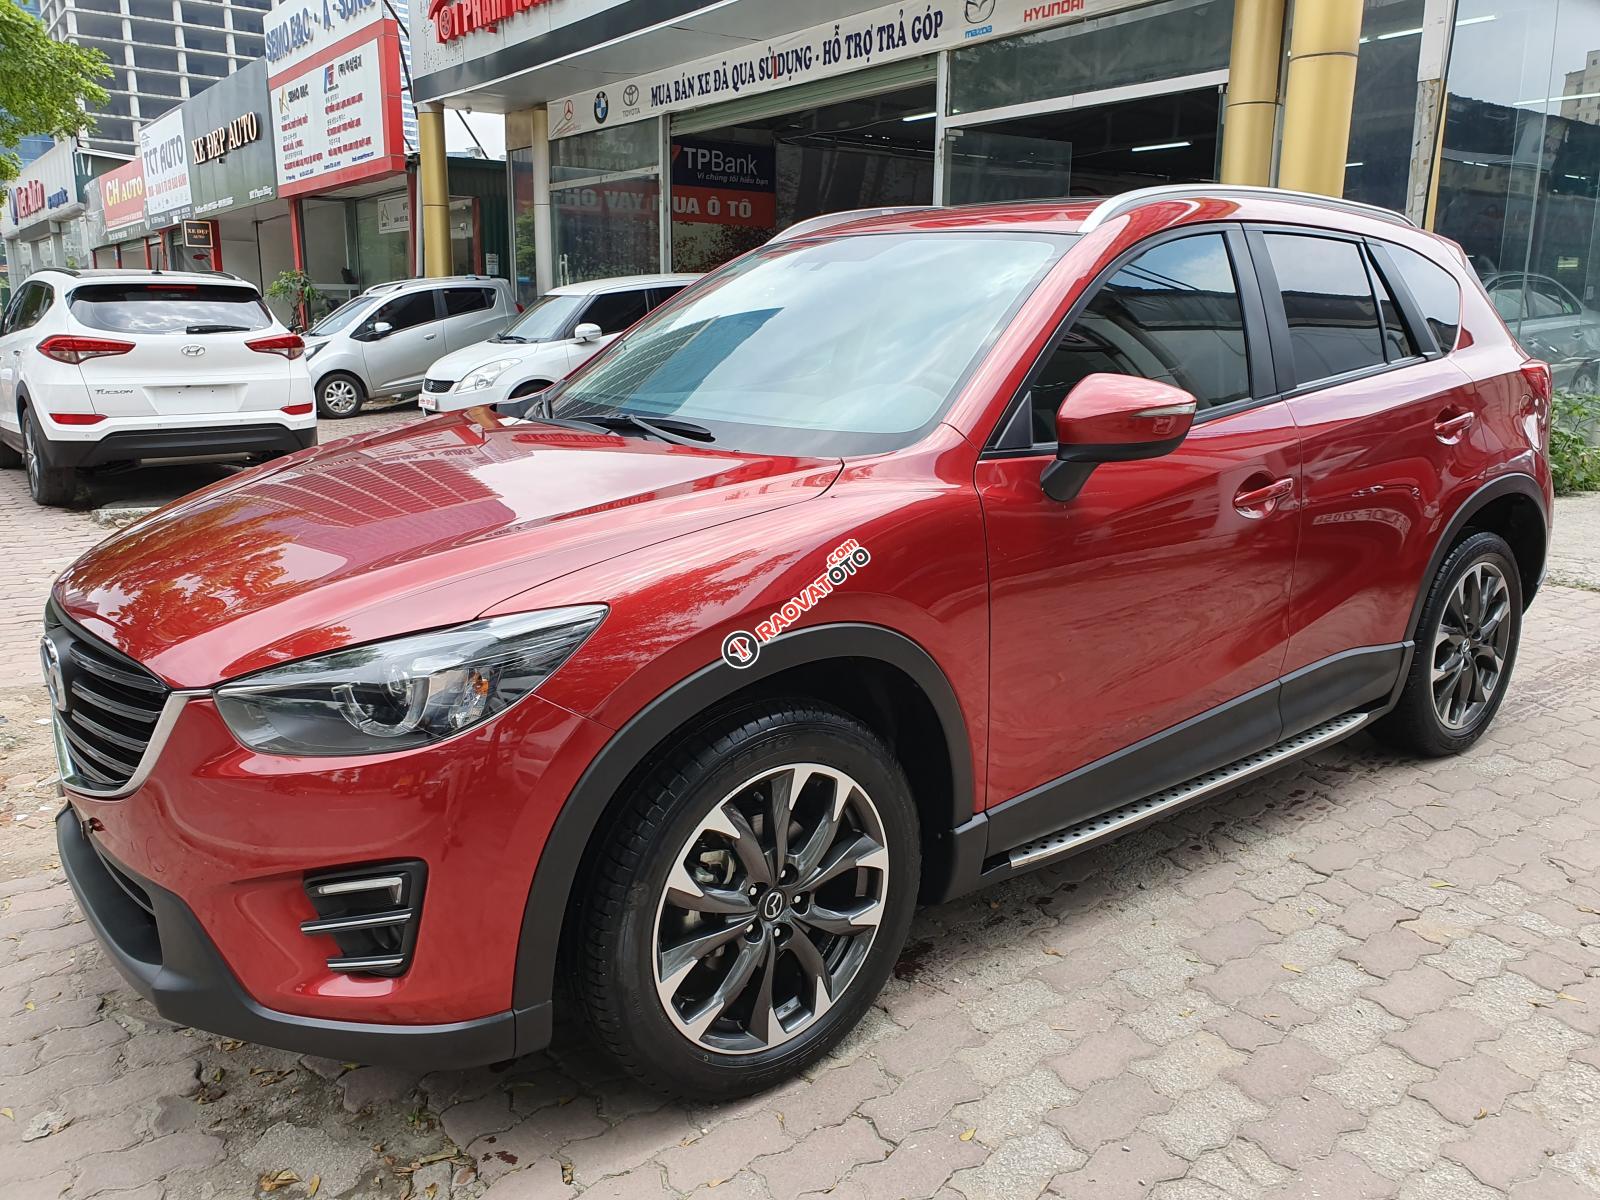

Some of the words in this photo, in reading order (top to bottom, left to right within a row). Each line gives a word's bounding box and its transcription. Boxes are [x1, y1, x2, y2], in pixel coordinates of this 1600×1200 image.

[1023, 0, 1085, 22] HYUNDAI
[650, 82, 672, 107] MUA
[674, 72, 695, 101] BÁN
[698, 71, 711, 96] XE
[714, 61, 729, 92] ĐÃ
[732, 60, 756, 92] QUA
[776, 45, 813, 81] DỤNG
[822, 24, 841, 66] HỖ
[845, 24, 873, 63] TRỢ
[876, 9, 907, 53] TRẢ
[911, 5, 943, 43] GÓP
[622, 107, 641, 117] TOYOTA
[191, 137, 206, 165] XE
[228, 112, 257, 150] AUTO
[144, 148, 159, 177] TCT
[160, 134, 184, 176] AUTO
[683, 147, 757, 175] TPBank
[106, 177, 120, 206] CH
[122, 175, 143, 200] AUTO
[727, 198, 752, 218] TÔ
